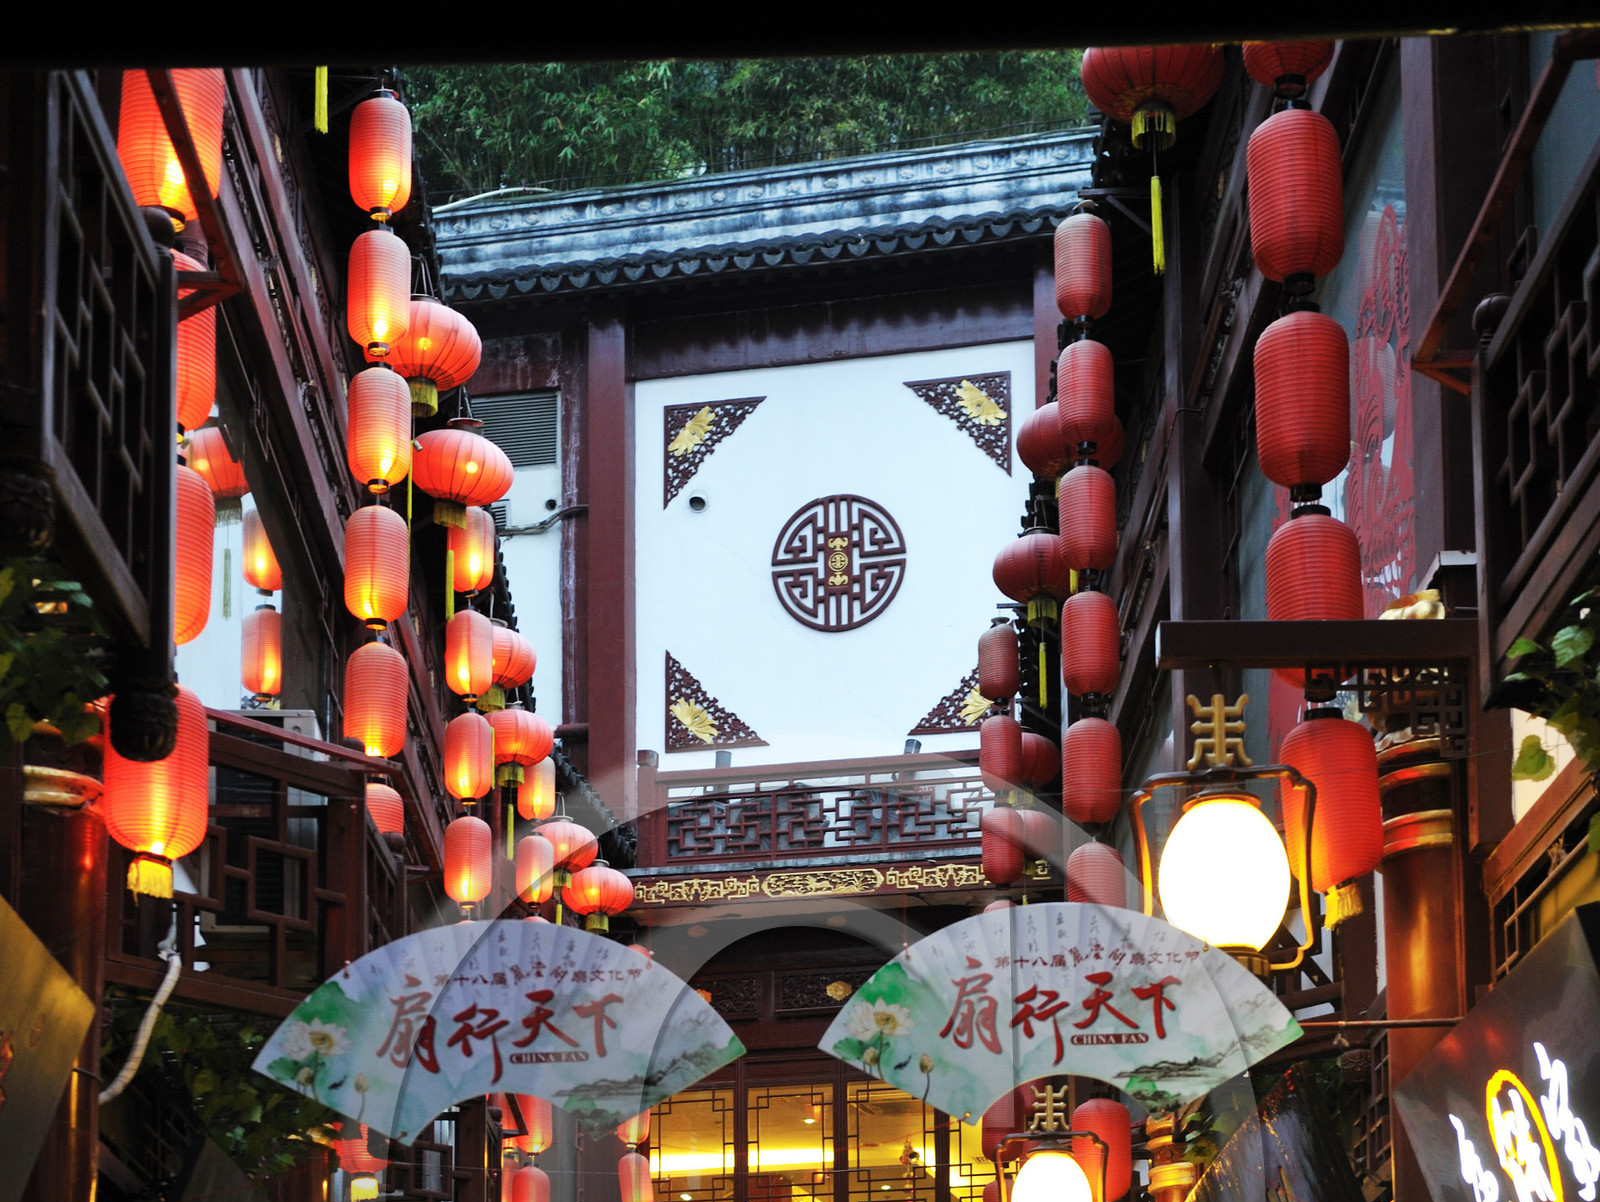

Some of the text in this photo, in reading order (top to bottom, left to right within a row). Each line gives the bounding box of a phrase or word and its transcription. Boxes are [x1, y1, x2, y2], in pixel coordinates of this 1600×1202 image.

[376, 973, 625, 1085] 扇行天下
[939, 956, 1183, 1066] 扇行天下
[1072, 1033, 1147, 1045] CHINA FAN
[511, 1051, 589, 1063] CHINA FAN
